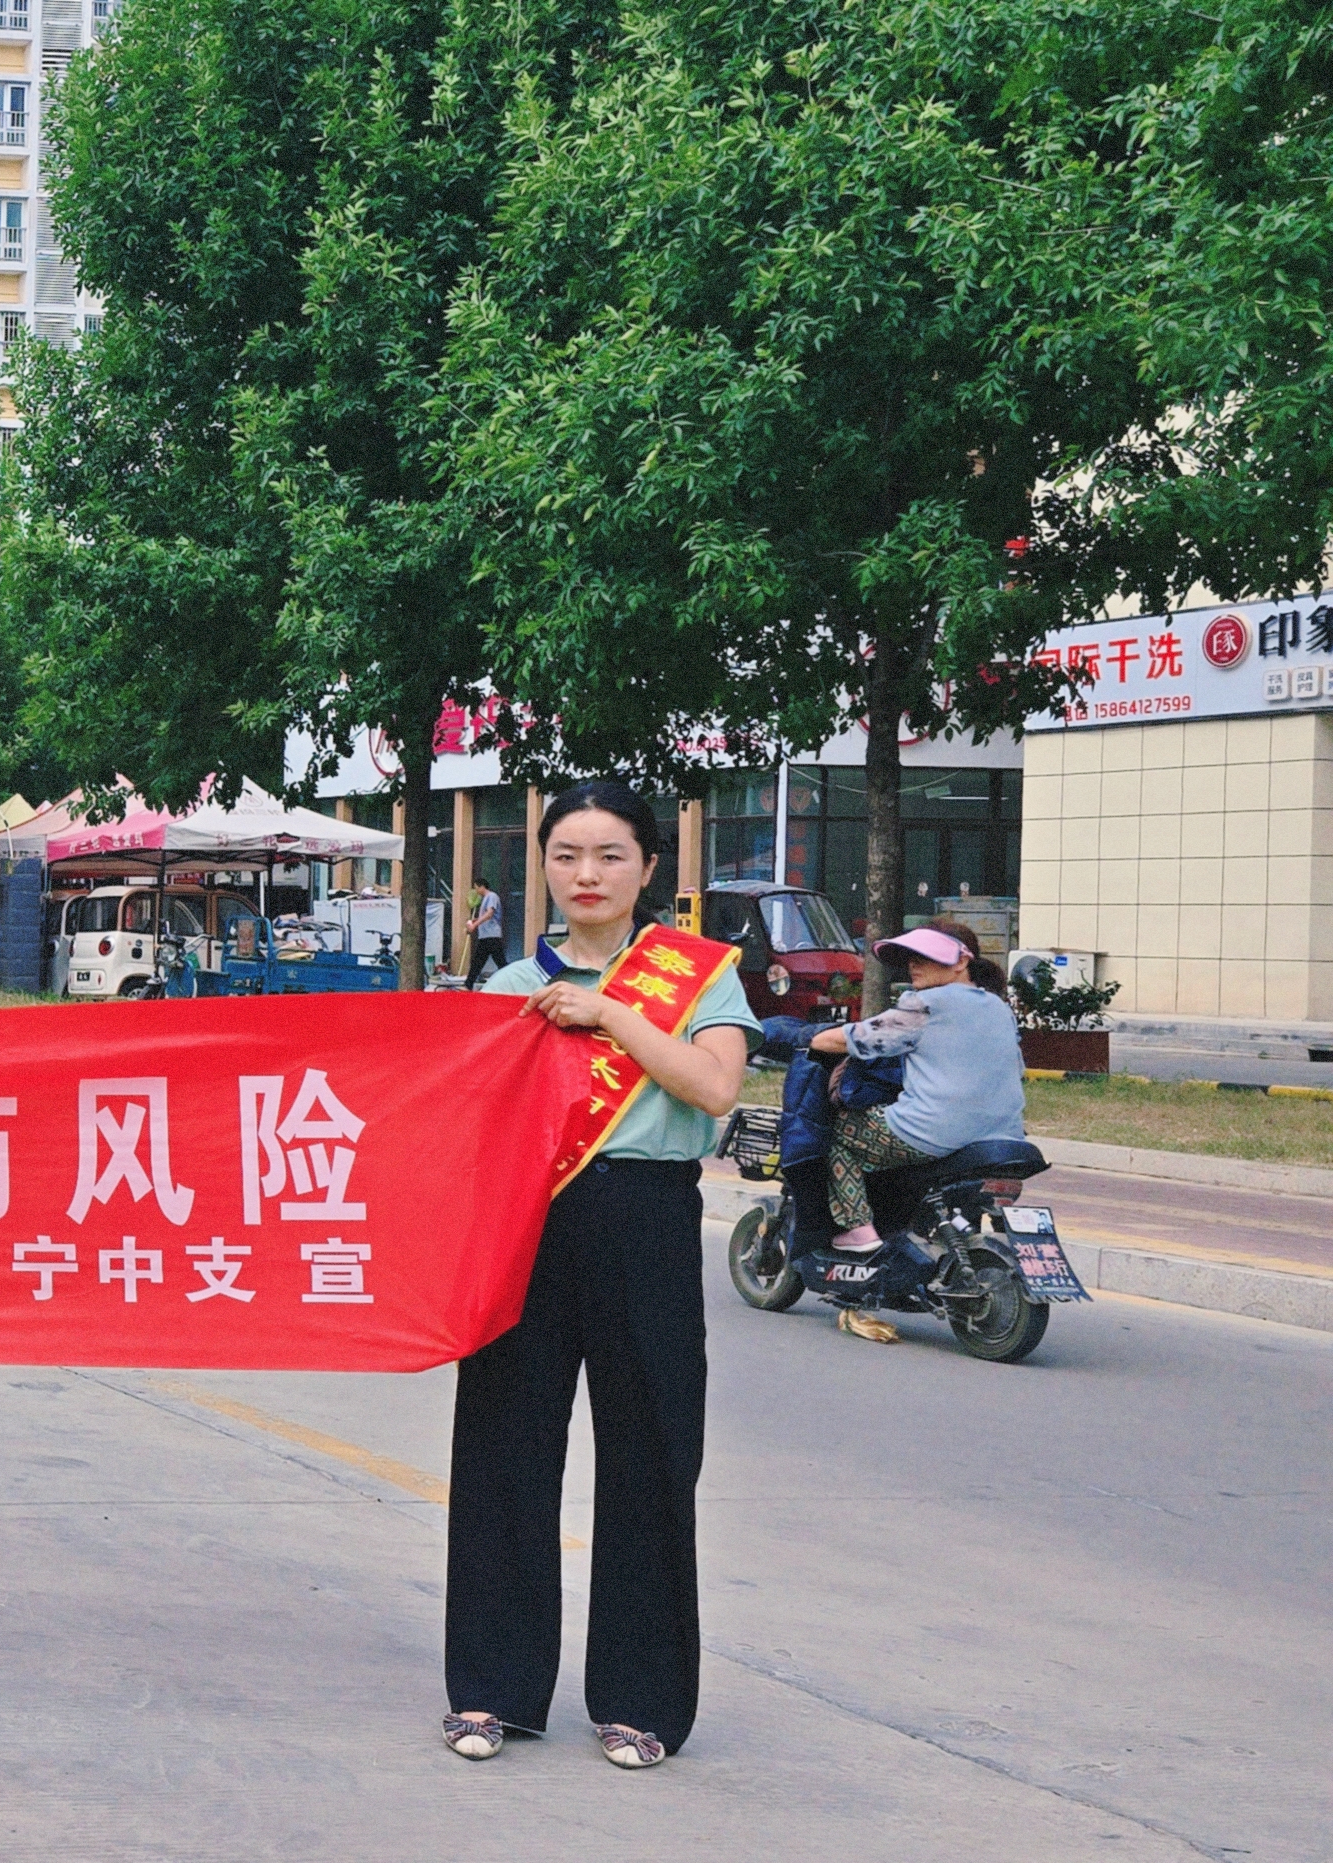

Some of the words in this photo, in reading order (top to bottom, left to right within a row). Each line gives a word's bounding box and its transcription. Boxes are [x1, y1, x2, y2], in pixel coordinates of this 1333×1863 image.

[1095, 696, 1192, 718] 15864127599
[622, 944, 697, 1005] 泰康
[300, 1237, 374, 1304] 宣
